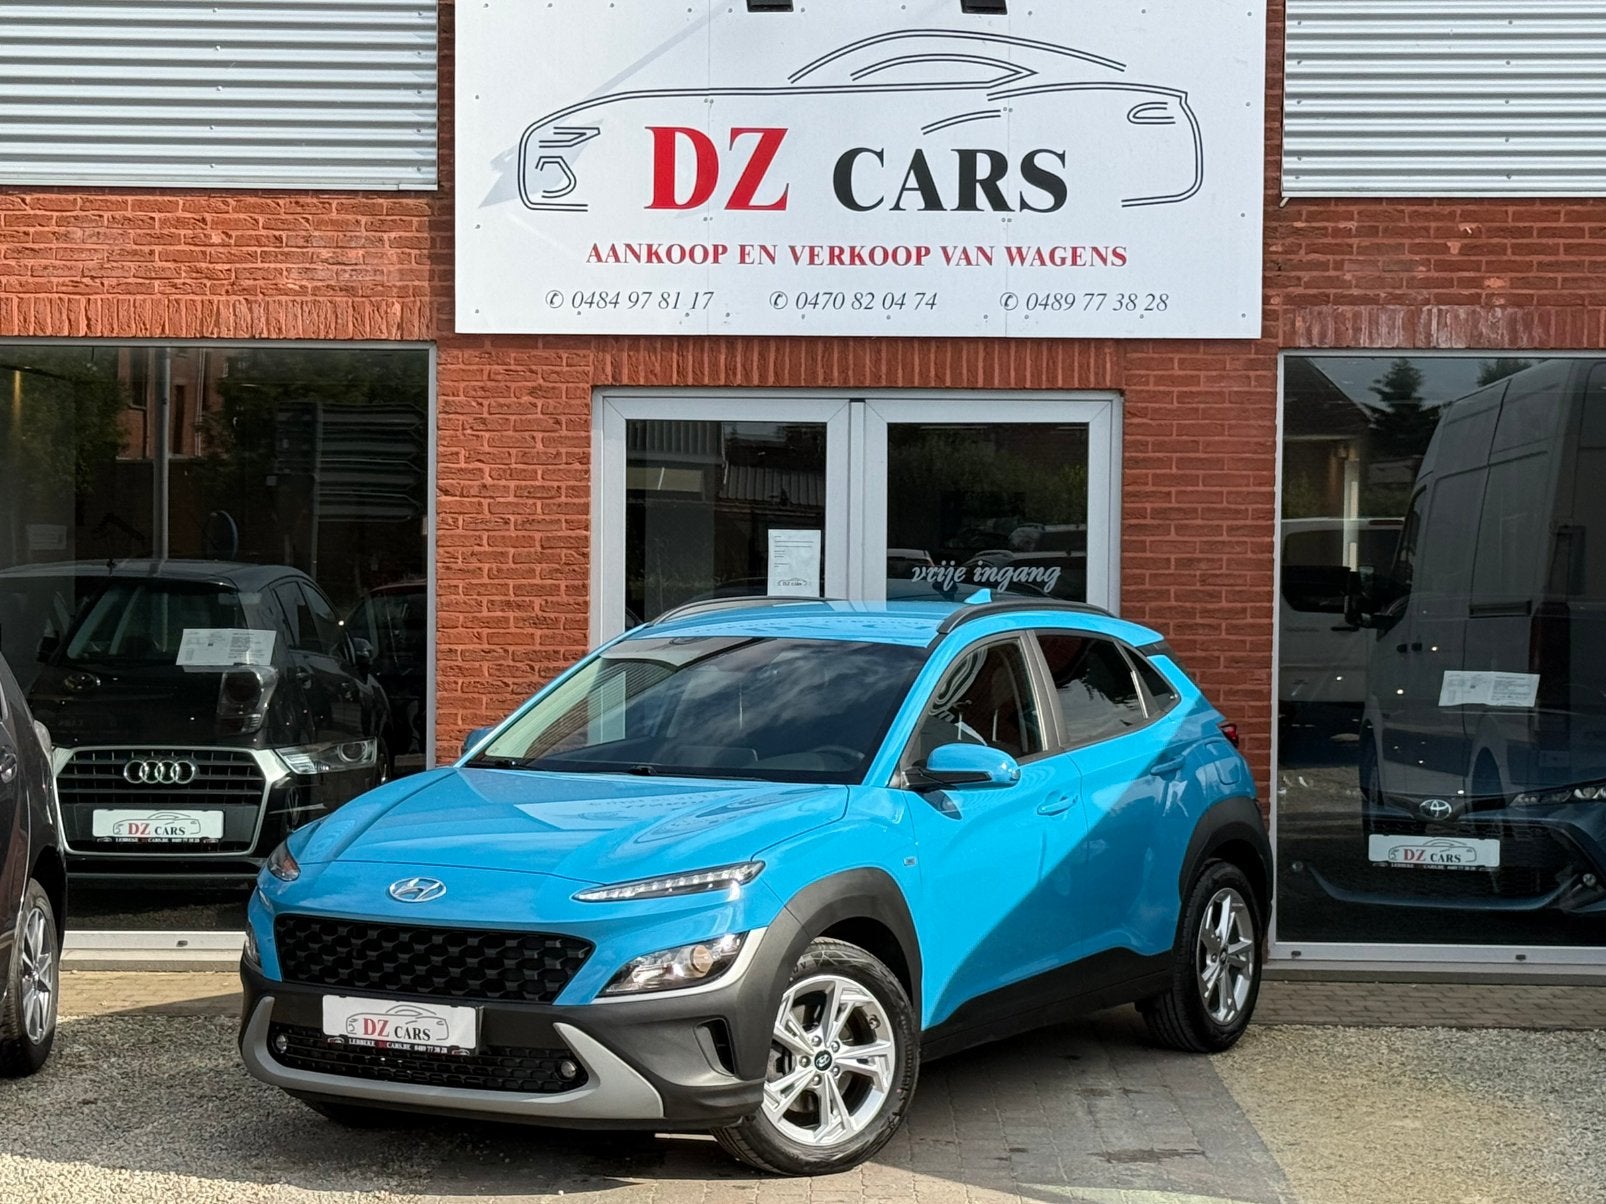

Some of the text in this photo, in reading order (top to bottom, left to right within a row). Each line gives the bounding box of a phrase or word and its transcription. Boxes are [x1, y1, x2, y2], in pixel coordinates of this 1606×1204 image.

[643, 126, 1068, 213] DZ CARS
[586, 242, 1128, 267] AANKOOP EN VERKOOP VAN WAGENS
[571, 290, 715, 310] 0484 97 81 17
[795, 291, 938, 311] 0470 82 04 74
[1026, 292, 1169, 311] 0489 77 38 28
[911, 560, 1062, 593] vrije ingang
[127, 822, 186, 836] DZ CARS
[1403, 848, 1462, 863] DZ CARS
[363, 1017, 431, 1041] DZ CARS
